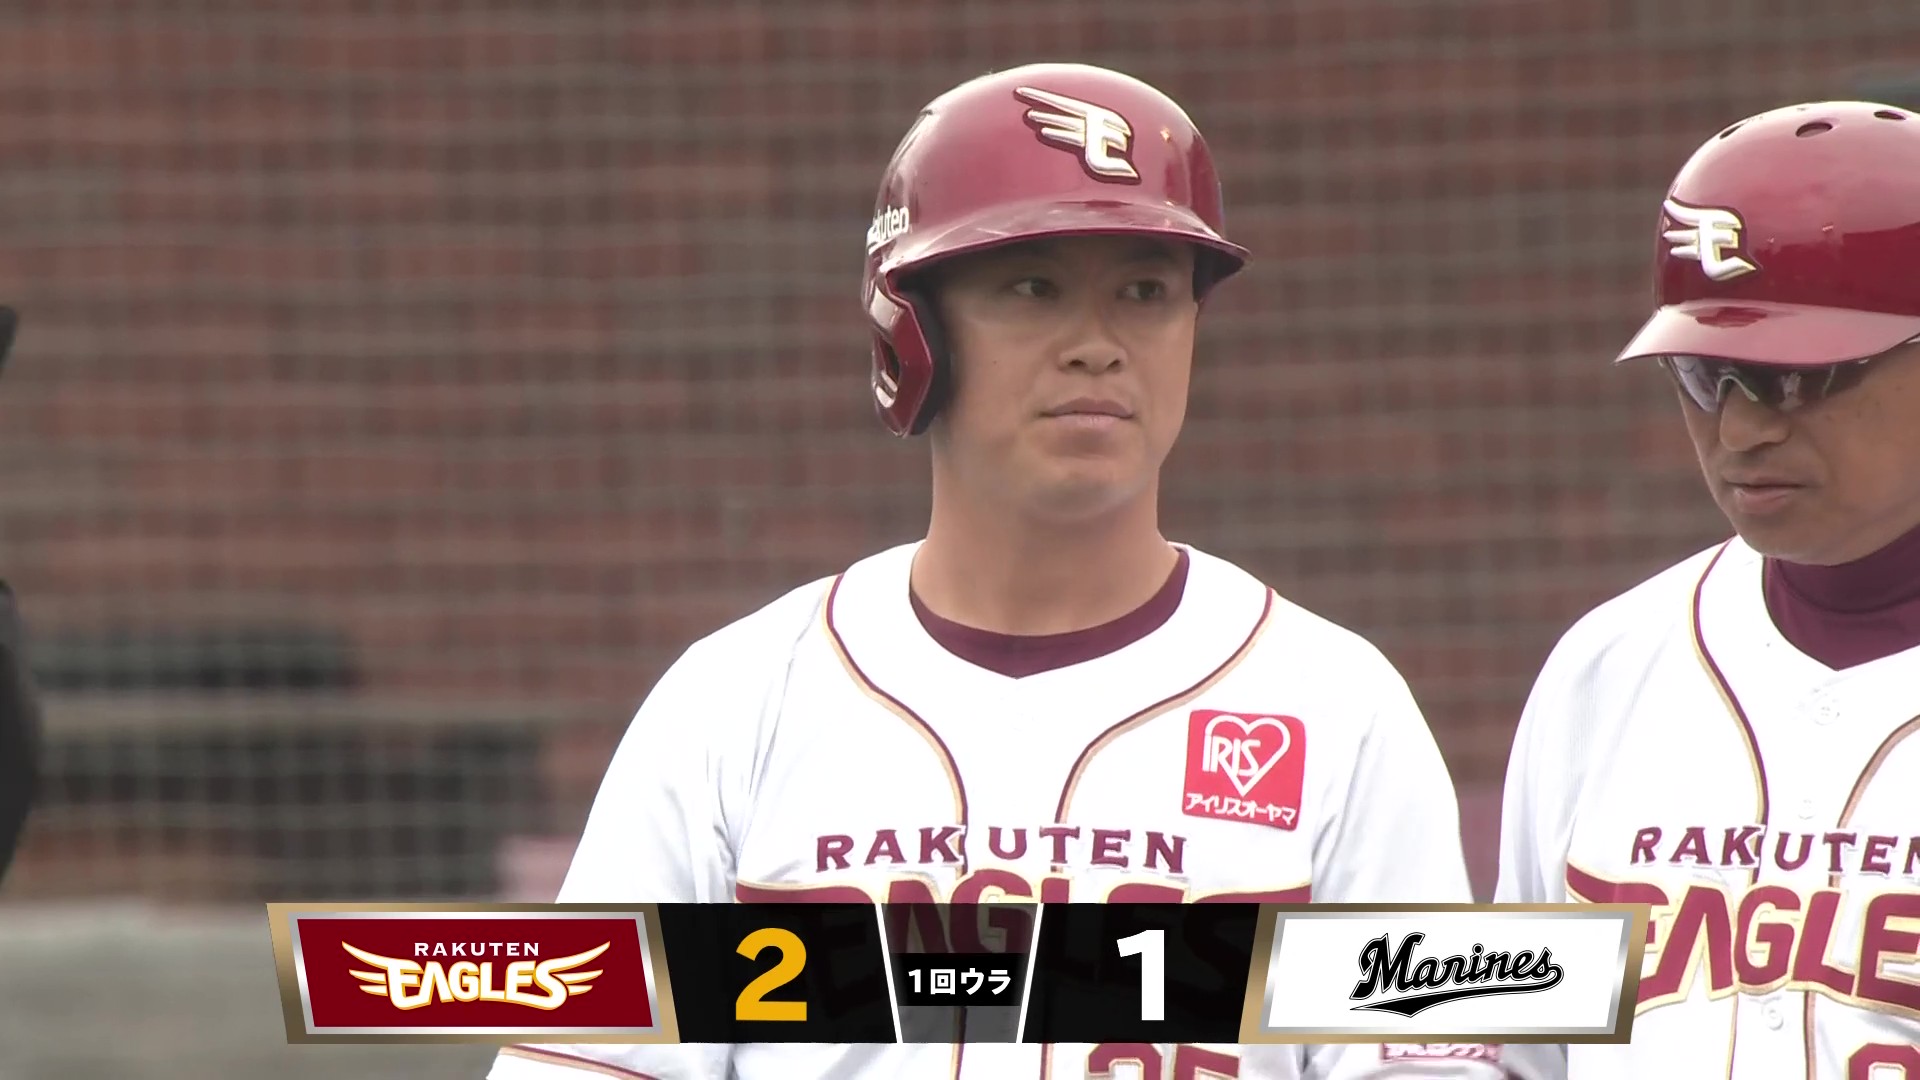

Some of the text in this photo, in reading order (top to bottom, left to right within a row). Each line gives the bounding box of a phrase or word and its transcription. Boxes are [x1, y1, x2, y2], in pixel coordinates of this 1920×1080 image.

[1202, 735, 1262, 776] IRIS
[1186, 792, 1297, 826] アイリスオーヤマ
[816, 826, 1187, 874] RAKUTEN
